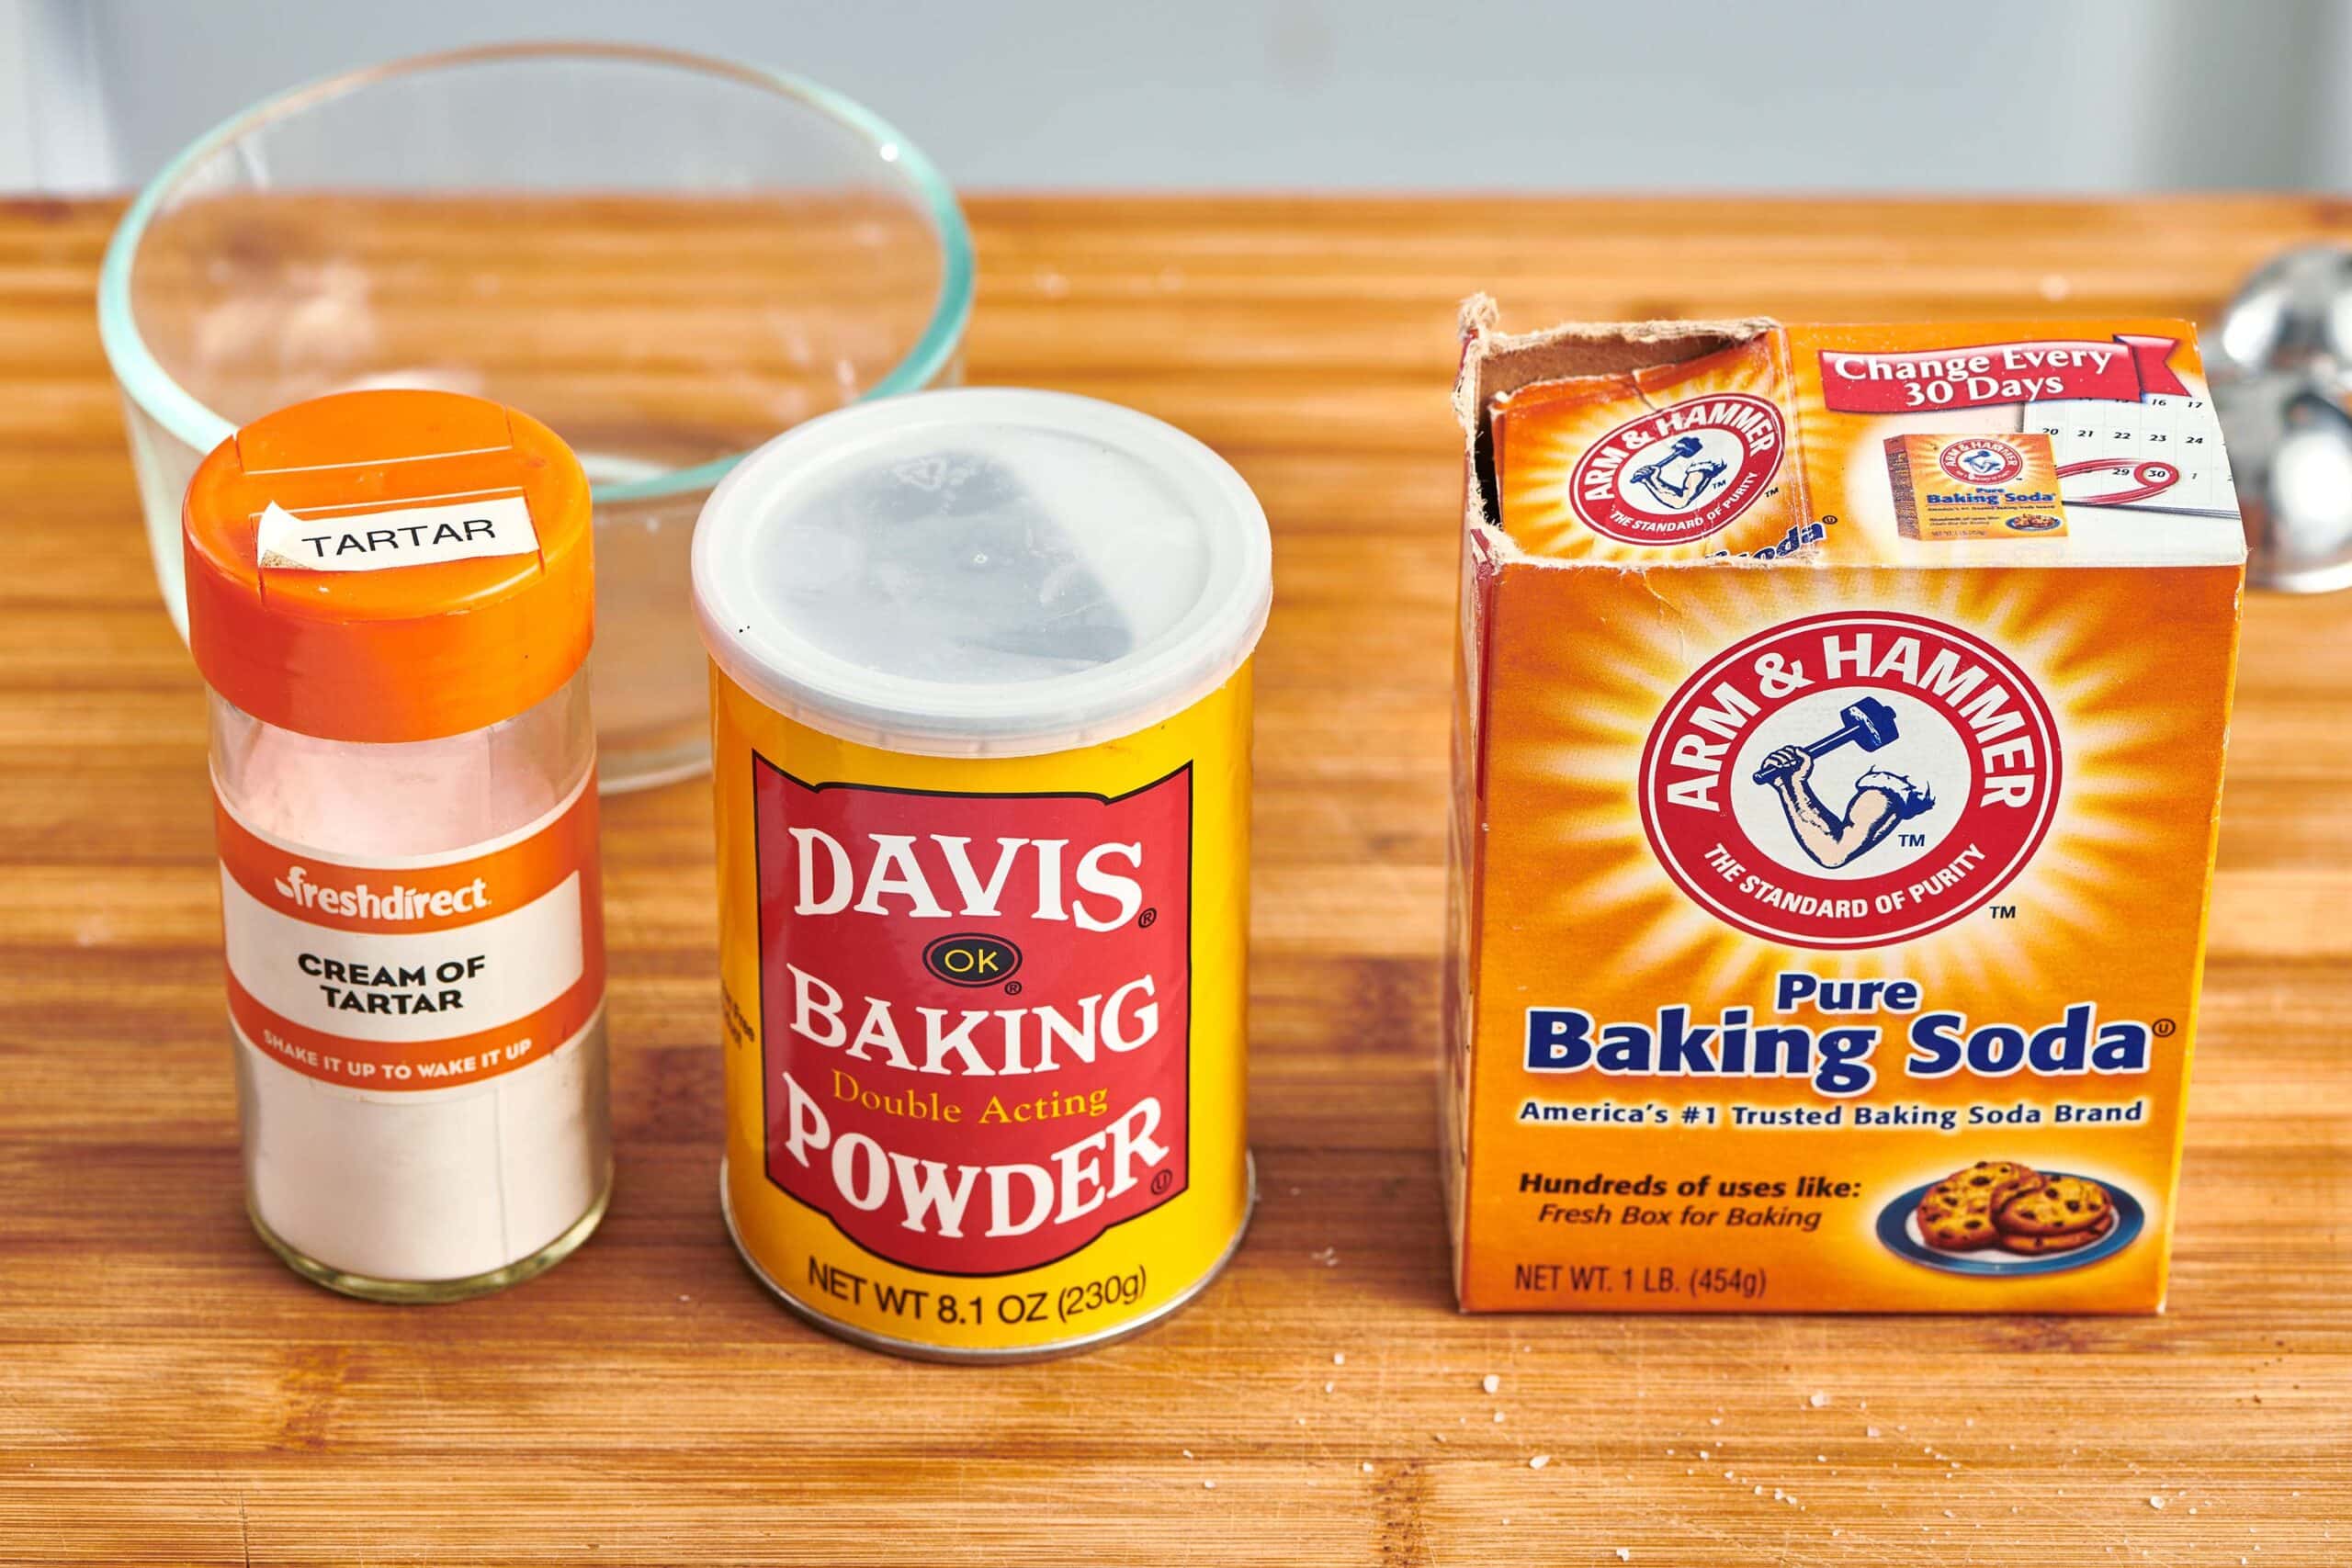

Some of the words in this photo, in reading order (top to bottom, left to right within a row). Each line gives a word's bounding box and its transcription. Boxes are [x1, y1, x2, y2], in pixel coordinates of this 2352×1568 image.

[1835, 352, 1990, 383] Change
[2003, 344, 2112, 374] Every
[1905, 380, 1954, 407] 30
[1968, 374, 2064, 404] Days
[2151, 399, 2167, 407] 16
[2187, 401, 2203, 410] 17
[1583, 446, 1631, 502] ARM
[1622, 429, 1655, 451] &
[1655, 401, 1775, 457] HAMMER
[2077, 430, 2094, 438] 21
[2113, 432, 2132, 440] 22
[2150, 434, 2166, 442] 23
[2186, 436, 2203, 445] 24
[2113, 468, 2130, 477] 29
[2148, 469, 2165, 478] 30
[1610, 511, 1634, 527] THE
[1633, 516, 1704, 533] STANDARD
[1707, 507, 1724, 521] OF
[1724, 472, 1758, 509] PURITY
[1927, 493, 1999, 505] Baking
[2005, 491, 2054, 502] Soda
[301, 518, 496, 558] TARTAR
[1668, 682, 1761, 812] ARM
[1753, 652, 1815, 699] &
[1822, 632, 2036, 808] HAMMER
[276, 866, 488, 921] freshdirect
[788, 826, 1144, 933] DAVIS
[1703, 842, 1739, 884] THE
[1739, 872, 1869, 919] STANDARD
[1876, 890, 1907, 915] OF
[1911, 842, 1986, 904] PURITY
[298, 953, 426, 987] CREAM
[435, 954, 486, 983] OF
[944, 948, 1001, 974] OK
[320, 985, 464, 1015] TARTAR
[1779, 974, 1917, 1010] Pure
[786, 962, 1159, 1077] BAKING
[263, 1029, 319, 1067] SHAKE
[323, 1056, 341, 1074] IT
[348, 1062, 375, 1077] UP
[381, 1065, 413, 1080] TO
[418, 1056, 476, 1079] WAKE
[481, 1048, 501, 1068] IT
[505, 1039, 532, 1063] UP
[1525, 1007, 1877, 1093] Baking
[1907, 1007, 2147, 1076] Soda
[831, 1069, 962, 1124] Double
[978, 1087, 1108, 1125] Acting
[1519, 1101, 1668, 1126] America's
[1680, 1105, 1717, 1125] #1
[1732, 1105, 1841, 1126] Trusted
[1854, 1104, 1957, 1131] Baking
[1969, 1103, 2041, 1125] Soda
[2054, 1101, 2143, 1123] Brand
[783, 1072, 1169, 1239] POWDER
[1519, 1173, 1668, 1198] Hundreds
[1677, 1175, 1712, 1198] of
[1718, 1179, 1789, 1200] uses
[1796, 1175, 1862, 1199] like:
[1539, 1204, 1611, 1225] Fresh
[1623, 1205, 1670, 1227] Box
[1682, 1204, 1718, 1228] for
[1726, 1206, 1823, 1232] Baking
[808, 1255, 866, 1299] NET
[873, 1282, 929, 1320] WT
[937, 1296, 982, 1326] 8.1
[998, 1292, 1048, 1325] OZ
[1057, 1266, 1148, 1325] (230g)
[1515, 1266, 1563, 1291] NET
[1569, 1267, 1611, 1292] WT.
[1623, 1269, 1634, 1291] 1
[1643, 1269, 1680, 1292] LB.
[1689, 1267, 1767, 1296] (454g)
